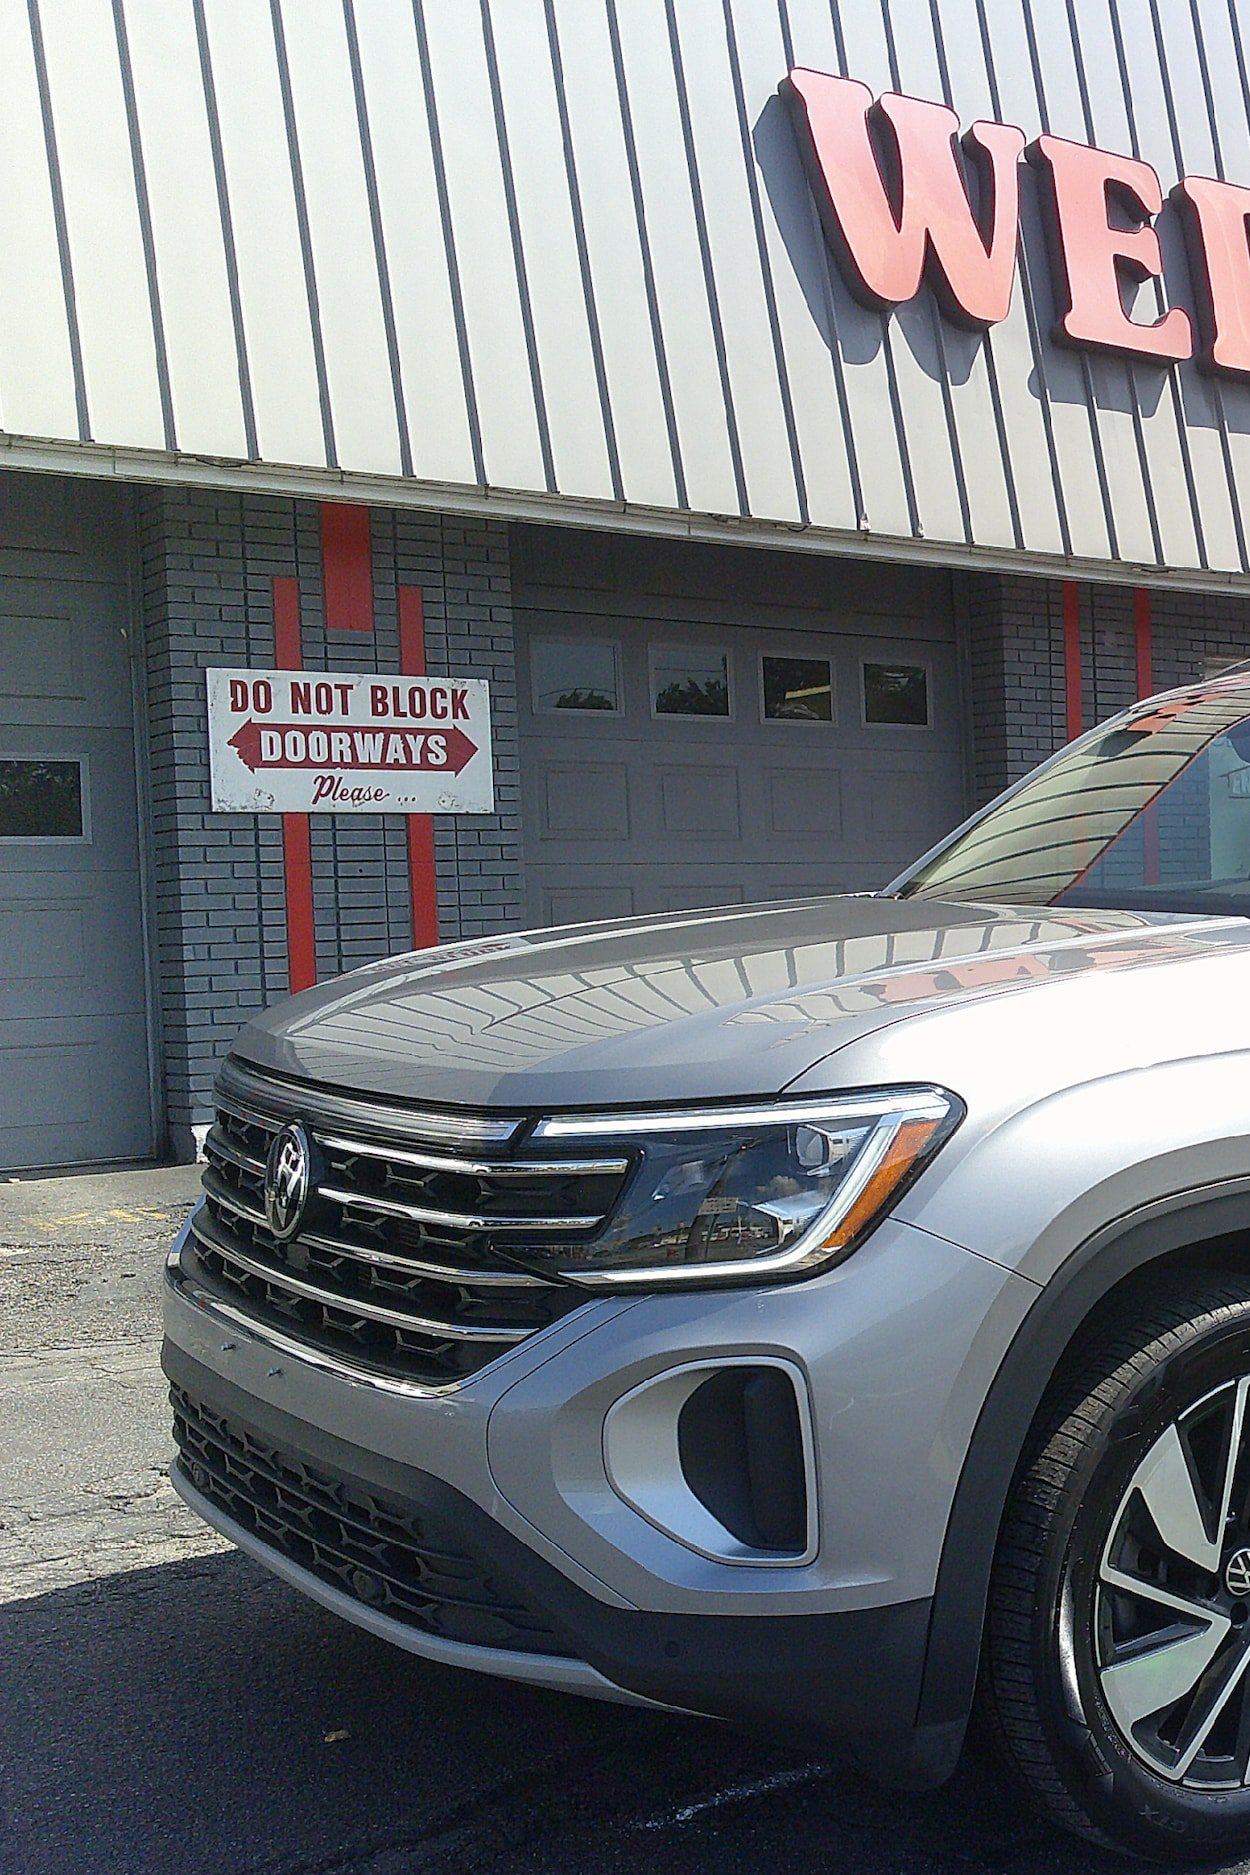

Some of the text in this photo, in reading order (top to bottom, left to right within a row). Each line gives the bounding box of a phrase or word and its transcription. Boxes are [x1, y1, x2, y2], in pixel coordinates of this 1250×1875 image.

[229, 679, 470, 720] DO NOT BLOCK
[260, 729, 448, 766] DOORWAYS
[311, 774, 390, 805] Please
